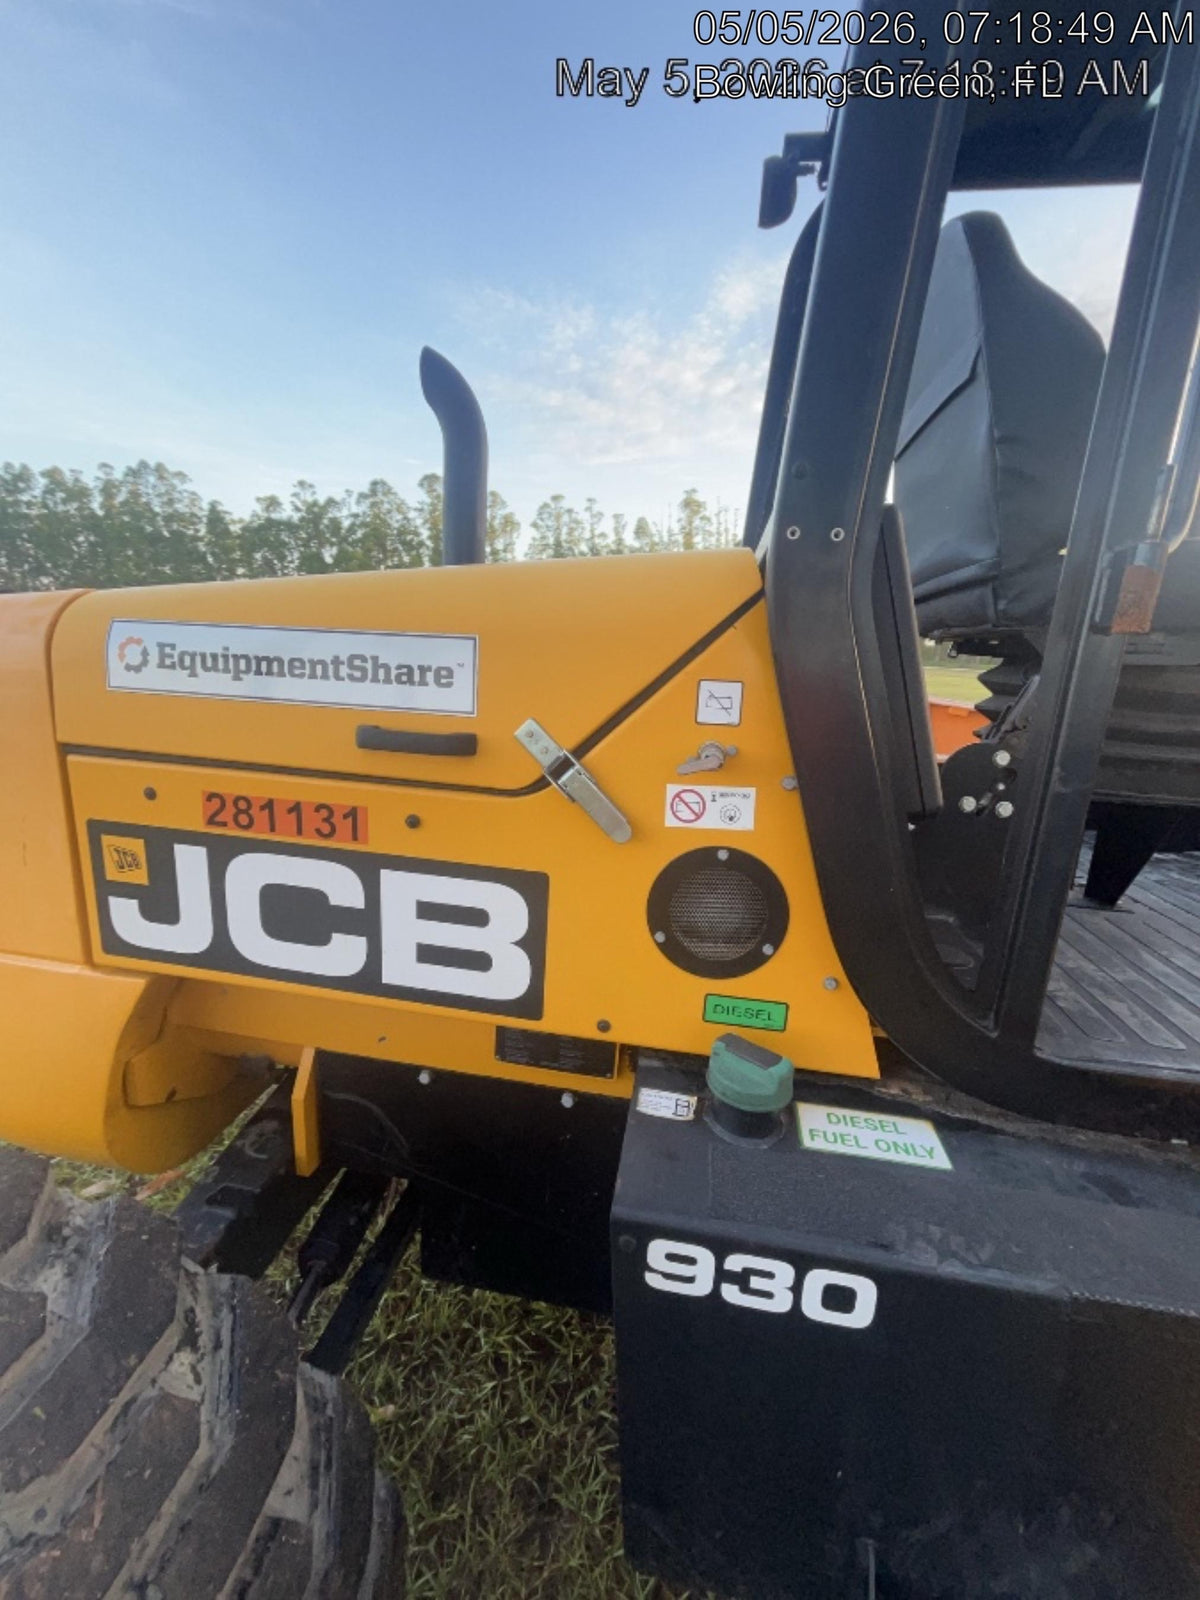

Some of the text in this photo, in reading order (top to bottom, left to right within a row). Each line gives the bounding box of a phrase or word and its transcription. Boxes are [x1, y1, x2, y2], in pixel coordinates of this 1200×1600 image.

[155, 641, 455, 689] EquipmentShare
[205, 792, 361, 842] 281131
[107, 843, 532, 1001] JCB
[712, 1003, 776, 1022] DIESEL
[808, 1128, 936, 1160] FUEL ONLY
[826, 1112, 907, 1135] DIESEL
[644, 1238, 878, 1329] 930
